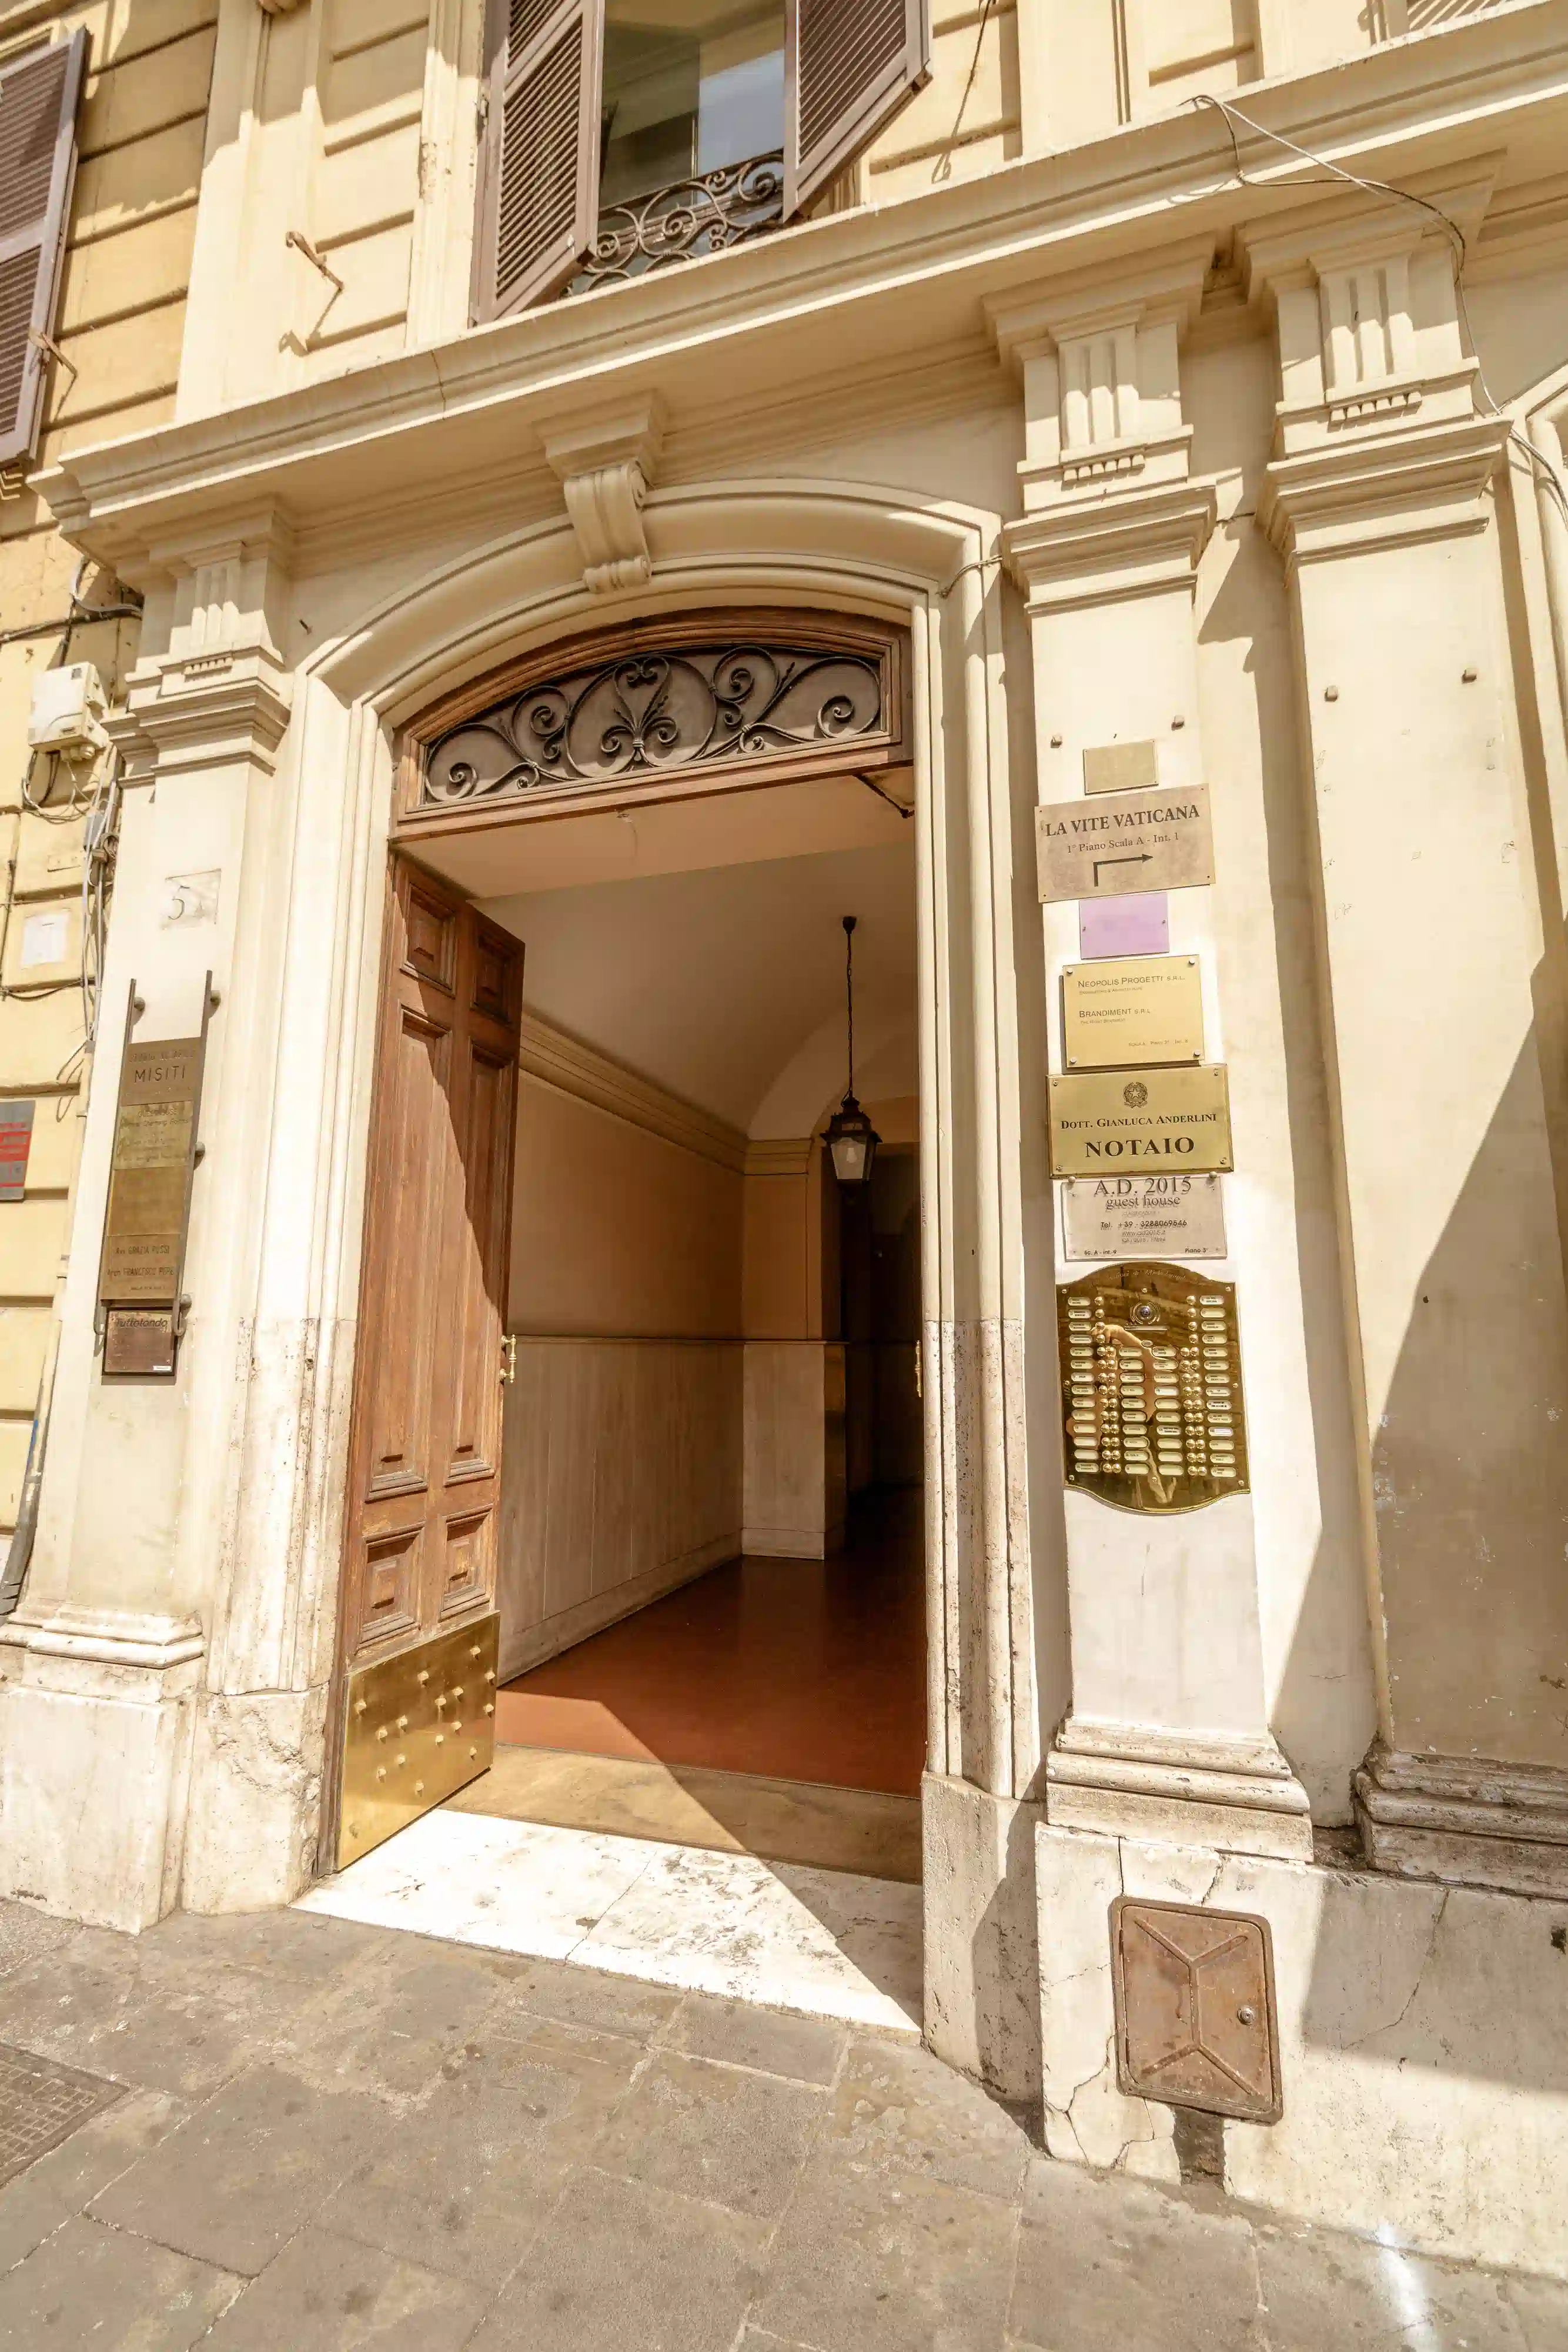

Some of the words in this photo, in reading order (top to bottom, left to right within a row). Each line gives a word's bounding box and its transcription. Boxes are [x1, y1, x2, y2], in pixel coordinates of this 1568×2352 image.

[1045, 822, 1067, 836] LA
[1070, 816, 1110, 833] VITE
[1112, 804, 1200, 828] VATICANA
[1079, 842, 1106, 852] Piano
[1109, 838, 1133, 848] Scala
[1136, 836, 1144, 846] A
[1154, 834, 1171, 843] Int.
[1174, 832, 1179, 840] 1
[1078, 978, 1119, 988] NEOPOLIS
[1121, 975, 1163, 985] PROGETTI
[1079, 1008, 1131, 1018] BRANDIMENT
[133, 1065, 186, 1083] MISITI
[1061, 1120, 1093, 1130] DOTT.
[1096, 1117, 1152, 1128] GIANLUCA
[1156, 1114, 1216, 1125] ANDERLINI
[1084, 1137, 1195, 1158] NOTAIO
[1094, 1178, 1138, 1195] A.D.
[1145, 1176, 1191, 1193] 2015
[1106, 1197, 1139, 1210] guest
[1143, 1194, 1181, 1206] house
